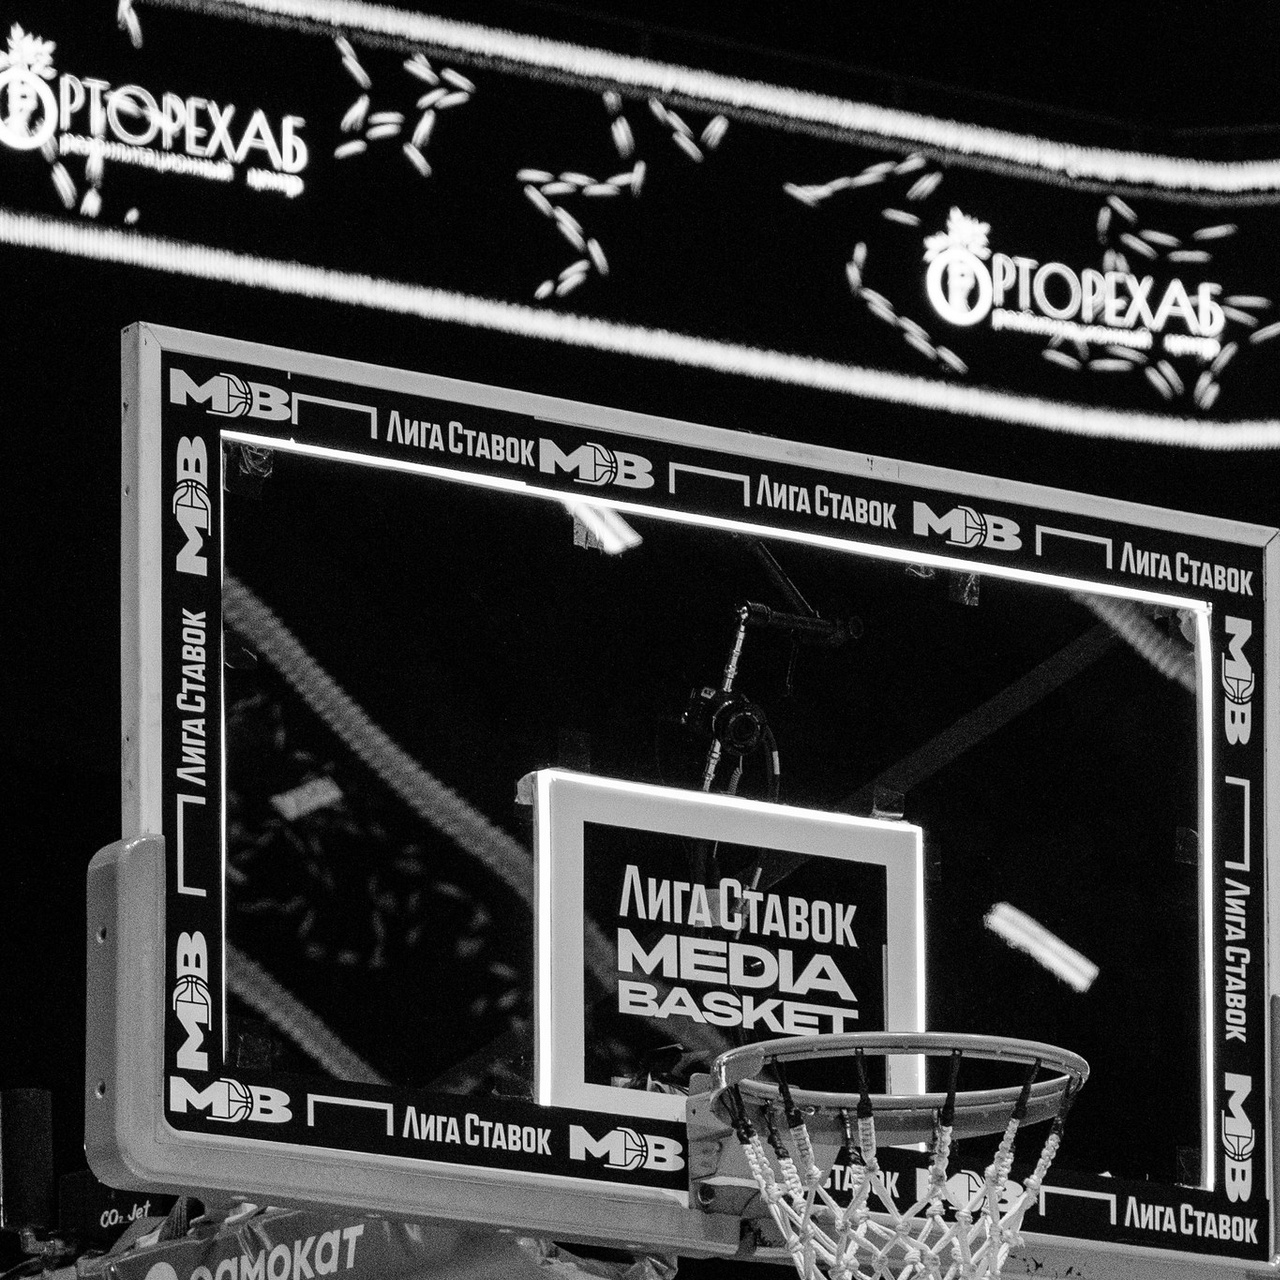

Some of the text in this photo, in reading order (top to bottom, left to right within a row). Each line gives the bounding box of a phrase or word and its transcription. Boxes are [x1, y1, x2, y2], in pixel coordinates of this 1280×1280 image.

[617, 928, 859, 1003] MEDIA
[618, 980, 859, 1036] BASKET
[128, 1200, 151, 1220] Jet
